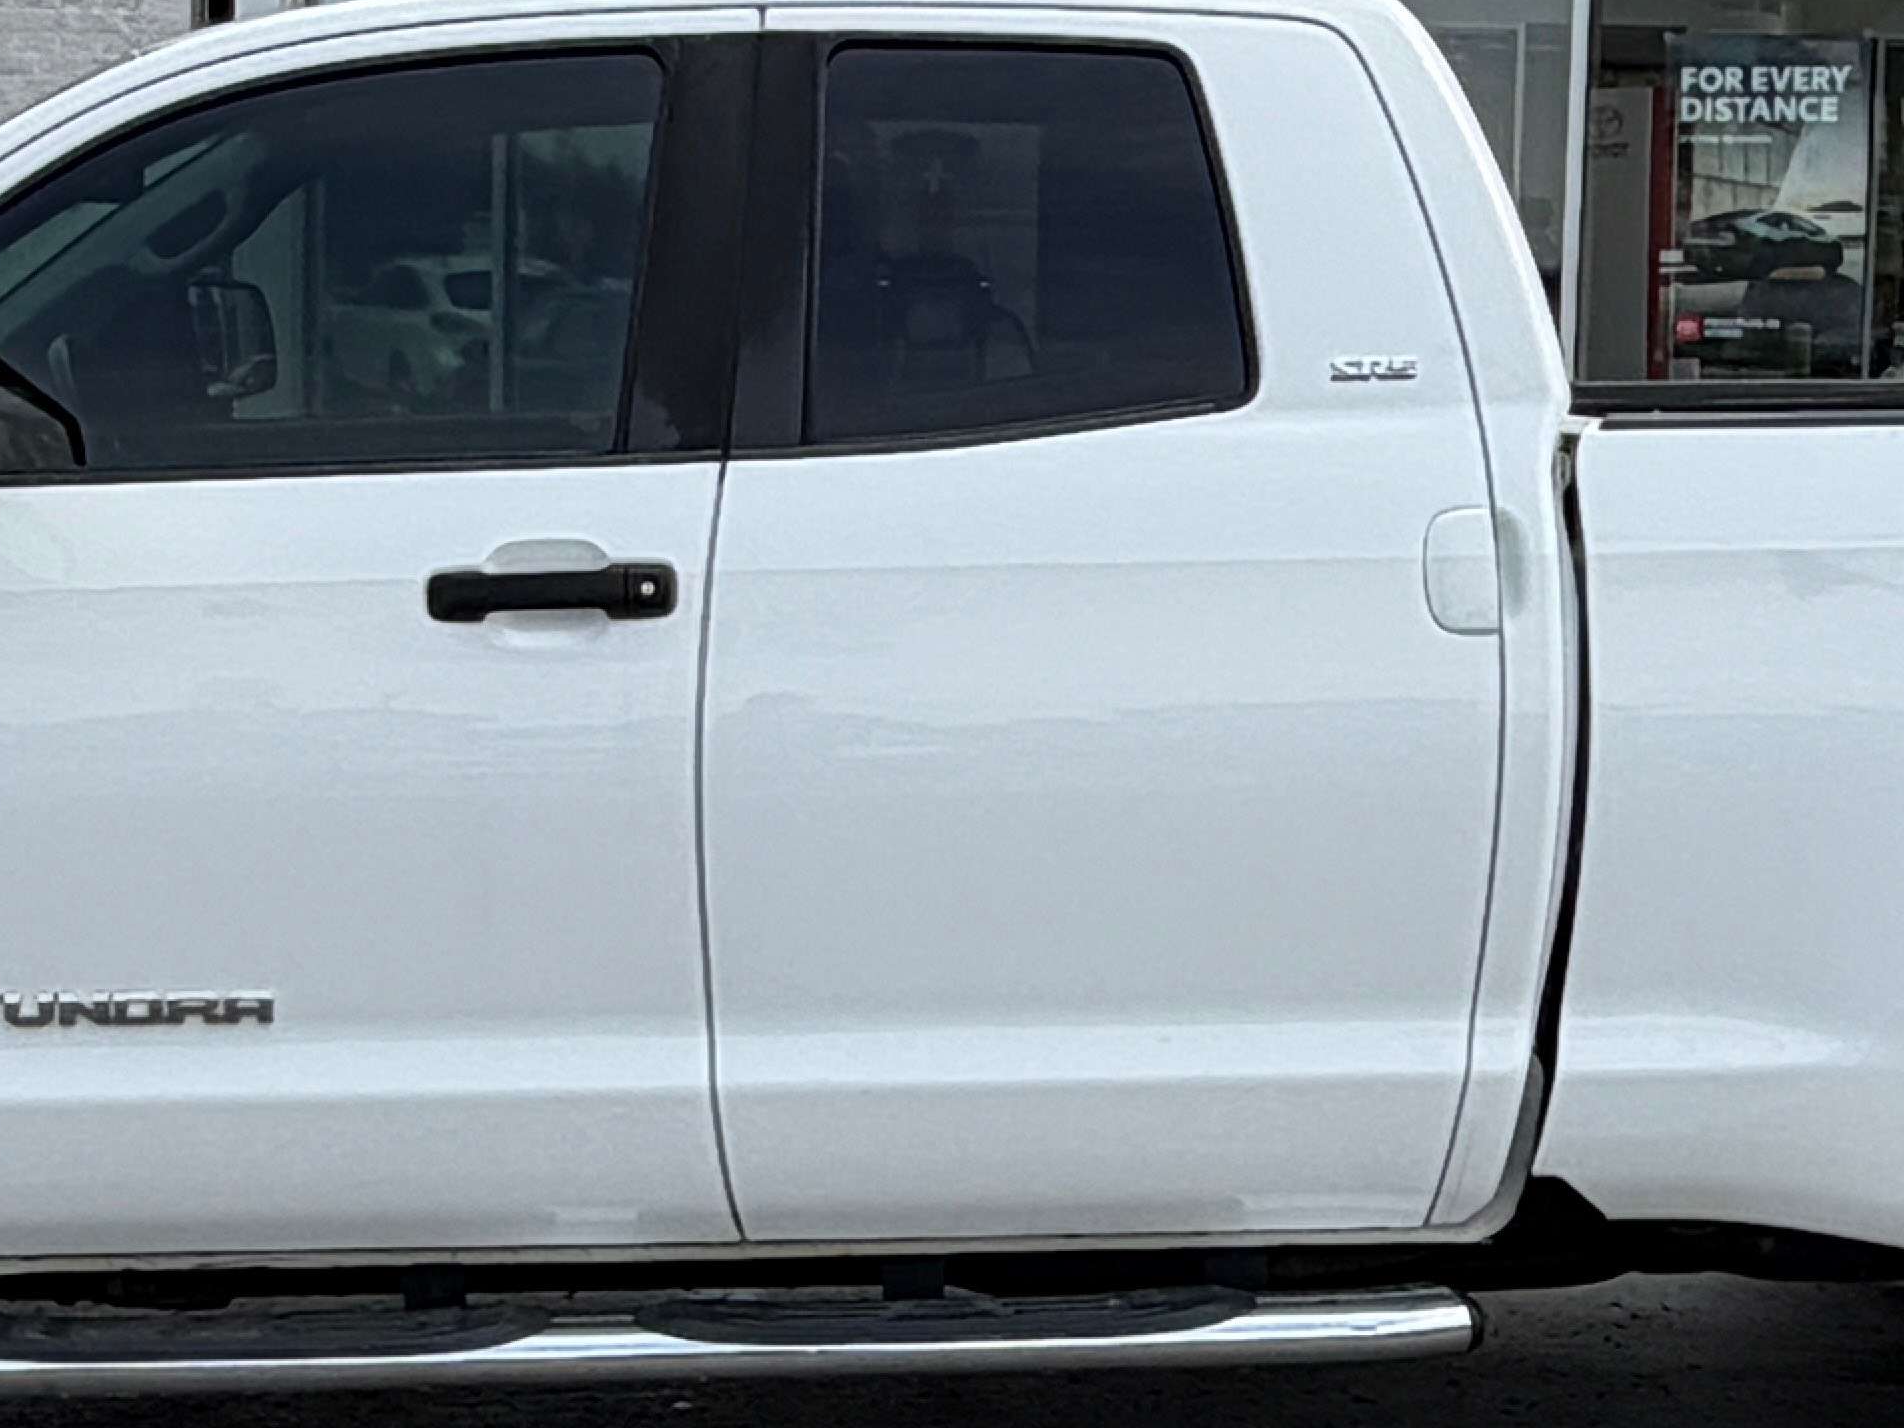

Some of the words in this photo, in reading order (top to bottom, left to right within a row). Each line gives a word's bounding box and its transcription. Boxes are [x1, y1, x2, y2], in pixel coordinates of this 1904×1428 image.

[1680, 65, 1744, 93] FOR
[1751, 64, 1853, 93] EVERY
[1679, 95, 1841, 123] DISTANCE
